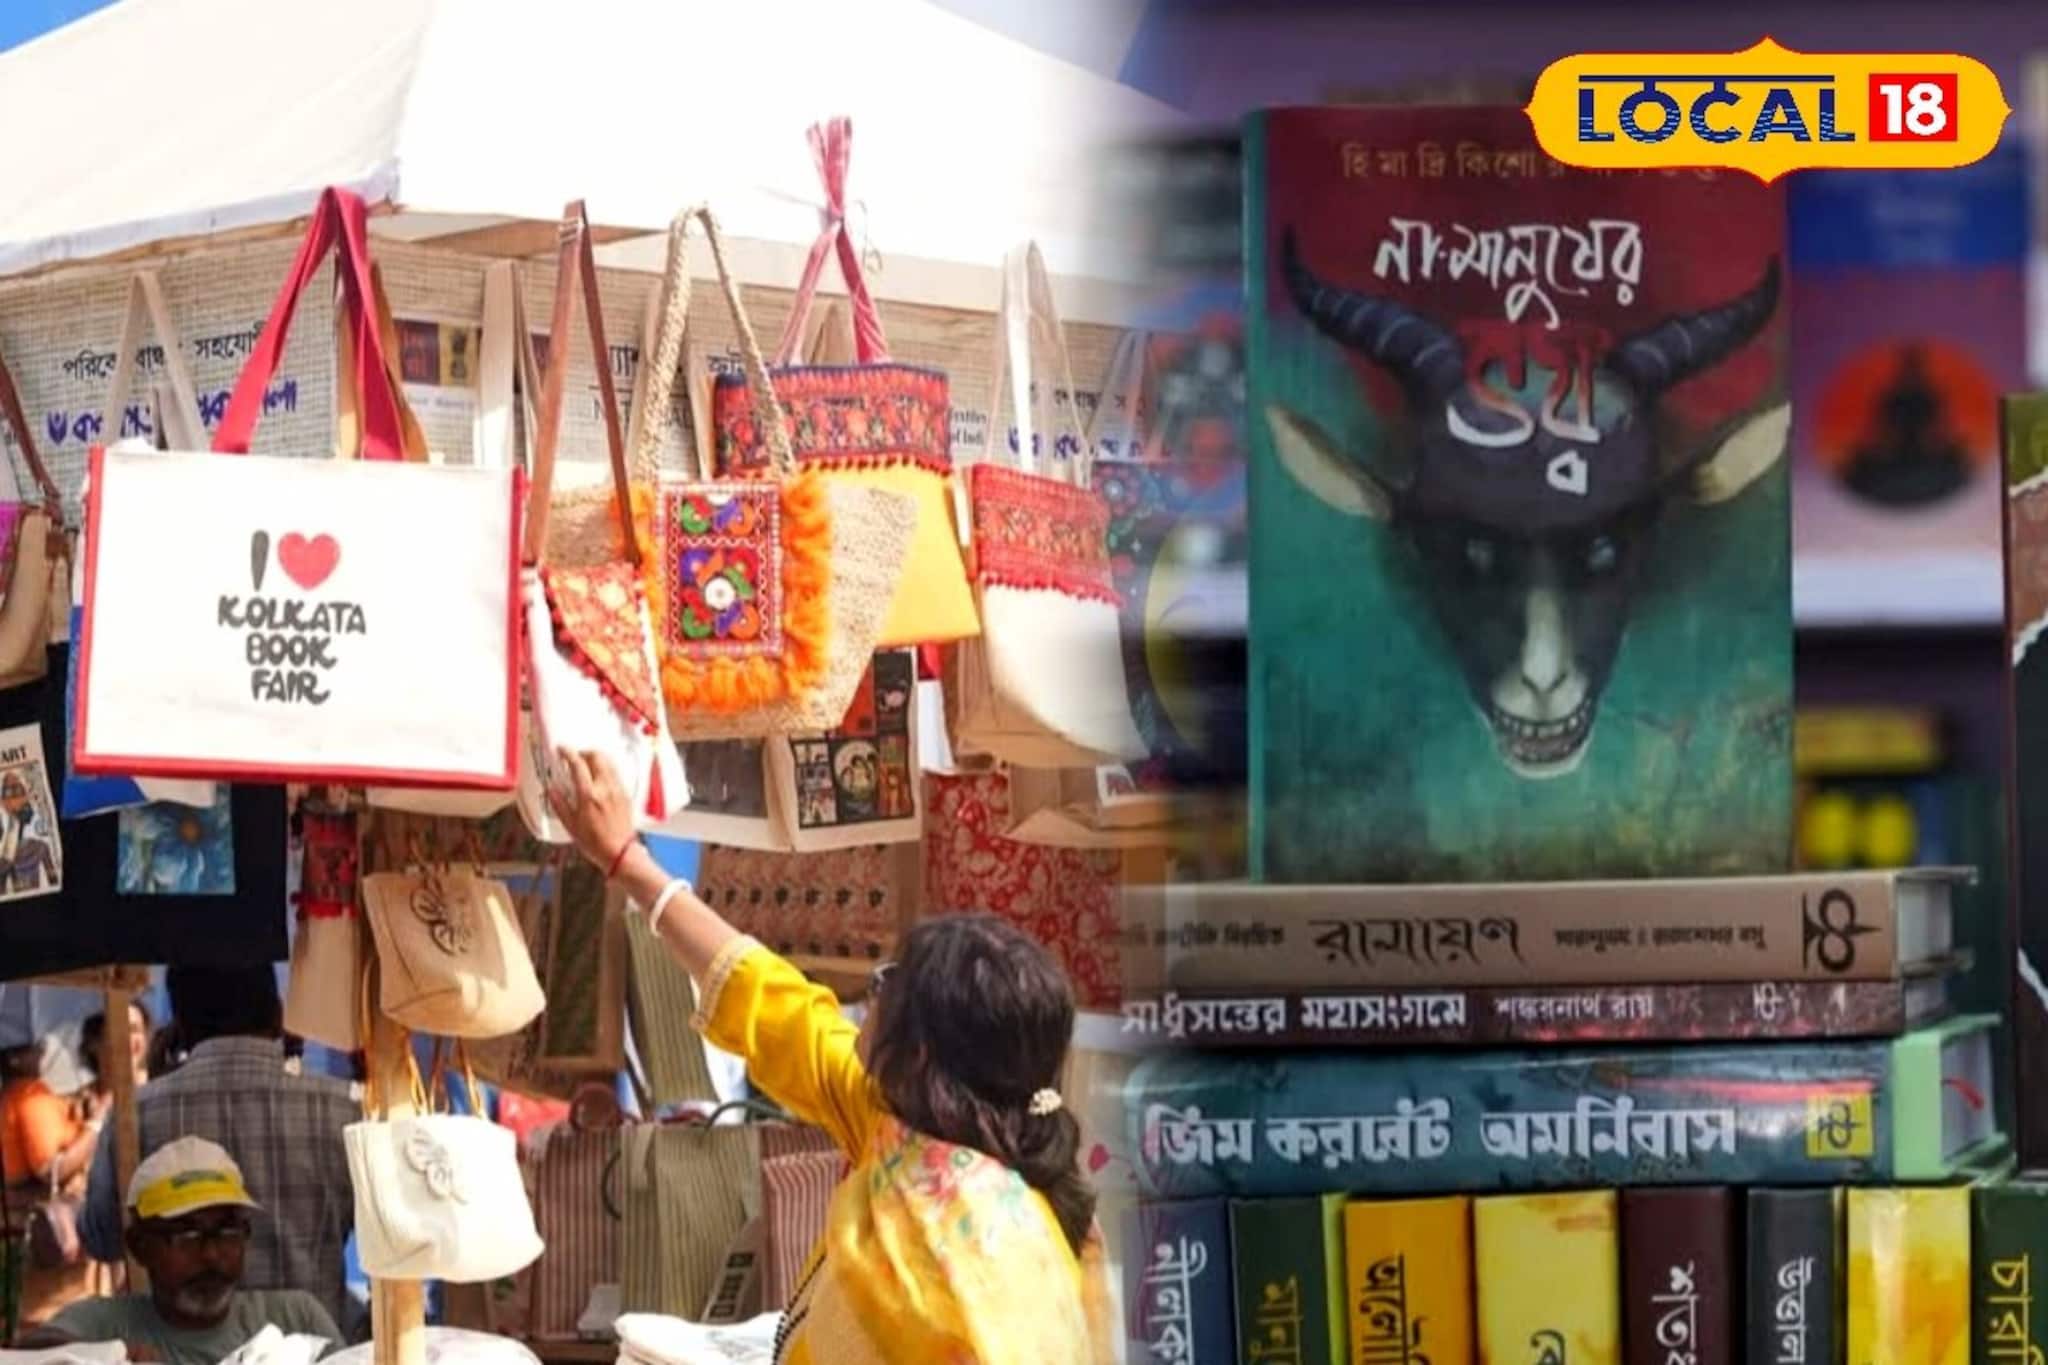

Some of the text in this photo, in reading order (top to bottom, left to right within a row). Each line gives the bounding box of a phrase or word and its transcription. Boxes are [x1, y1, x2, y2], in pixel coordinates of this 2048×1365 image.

[217, 595, 366, 635] KOLKATA
[246, 632, 338, 670] BOOK
[251, 668, 331, 706] FAIR
[1309, 917, 1530, 967] রামায়ণ
[1480, 1095, 1736, 1161] অমনিবাস
